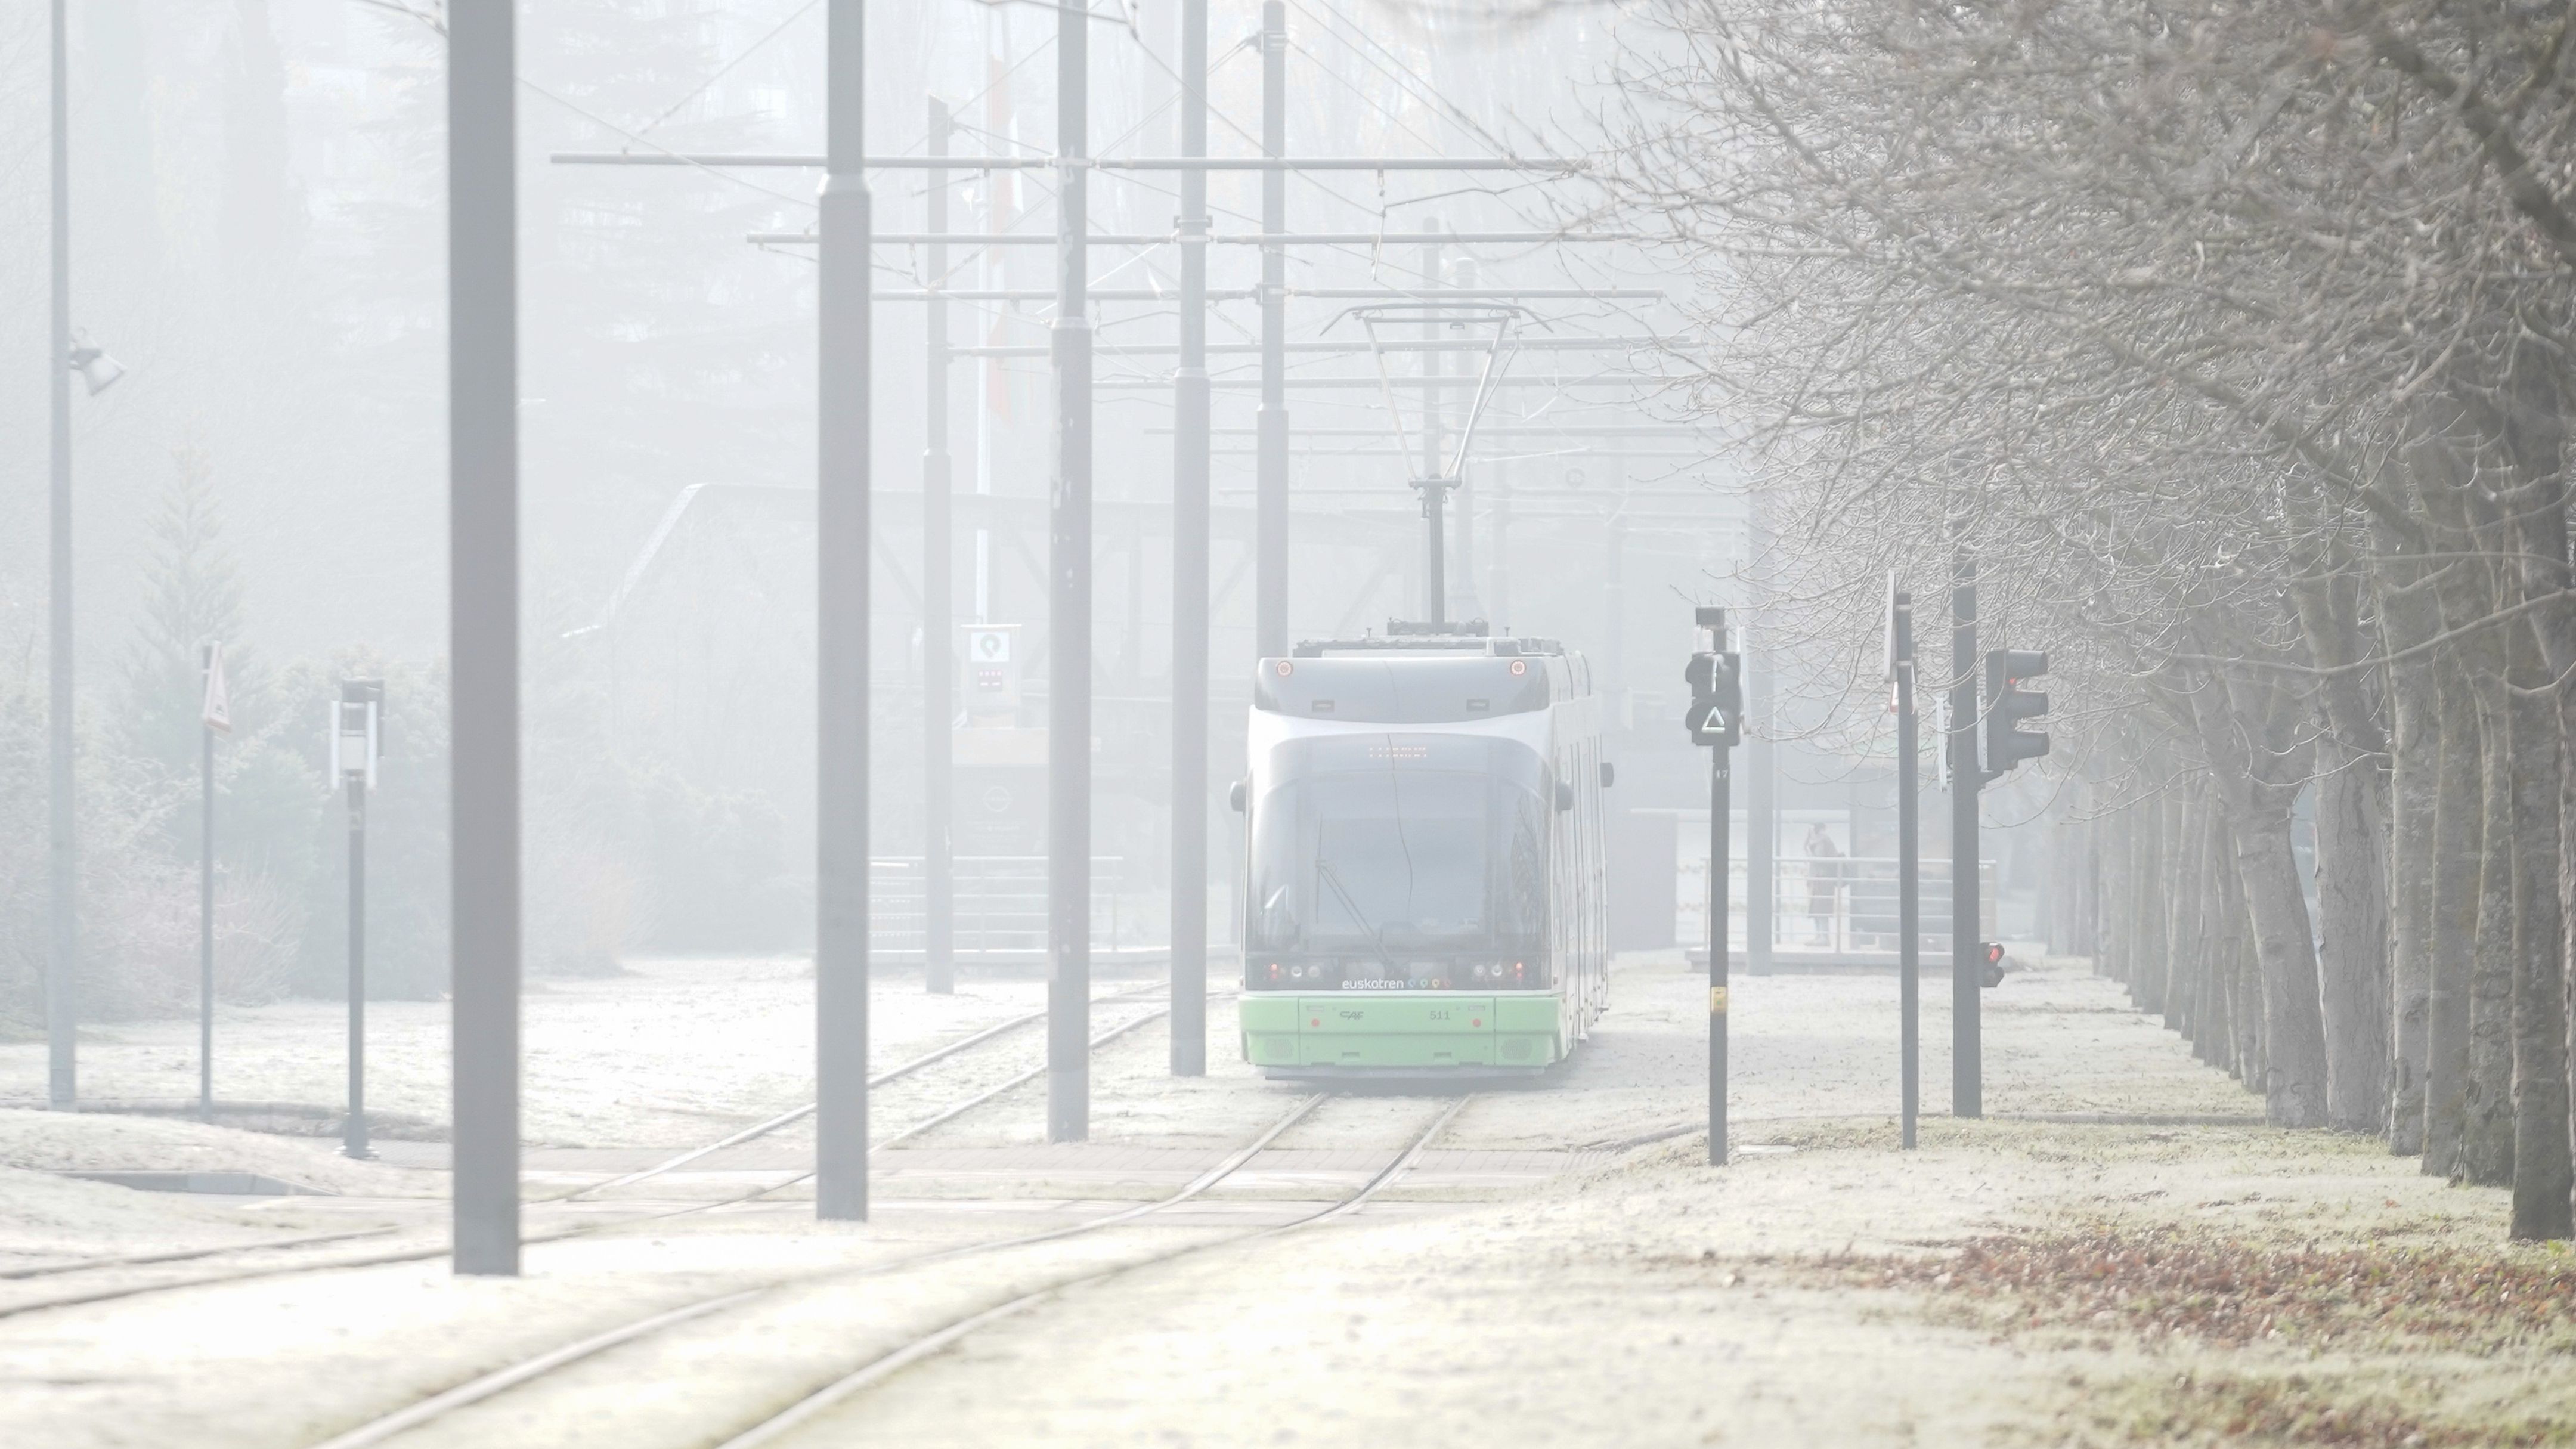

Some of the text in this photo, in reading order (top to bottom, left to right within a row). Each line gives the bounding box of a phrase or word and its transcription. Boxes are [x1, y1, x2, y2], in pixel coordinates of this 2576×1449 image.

[1342, 977, 1404, 989] euskotren
[1339, 1011, 1364, 1020] CAF
[1429, 1011, 1451, 1020] 511
